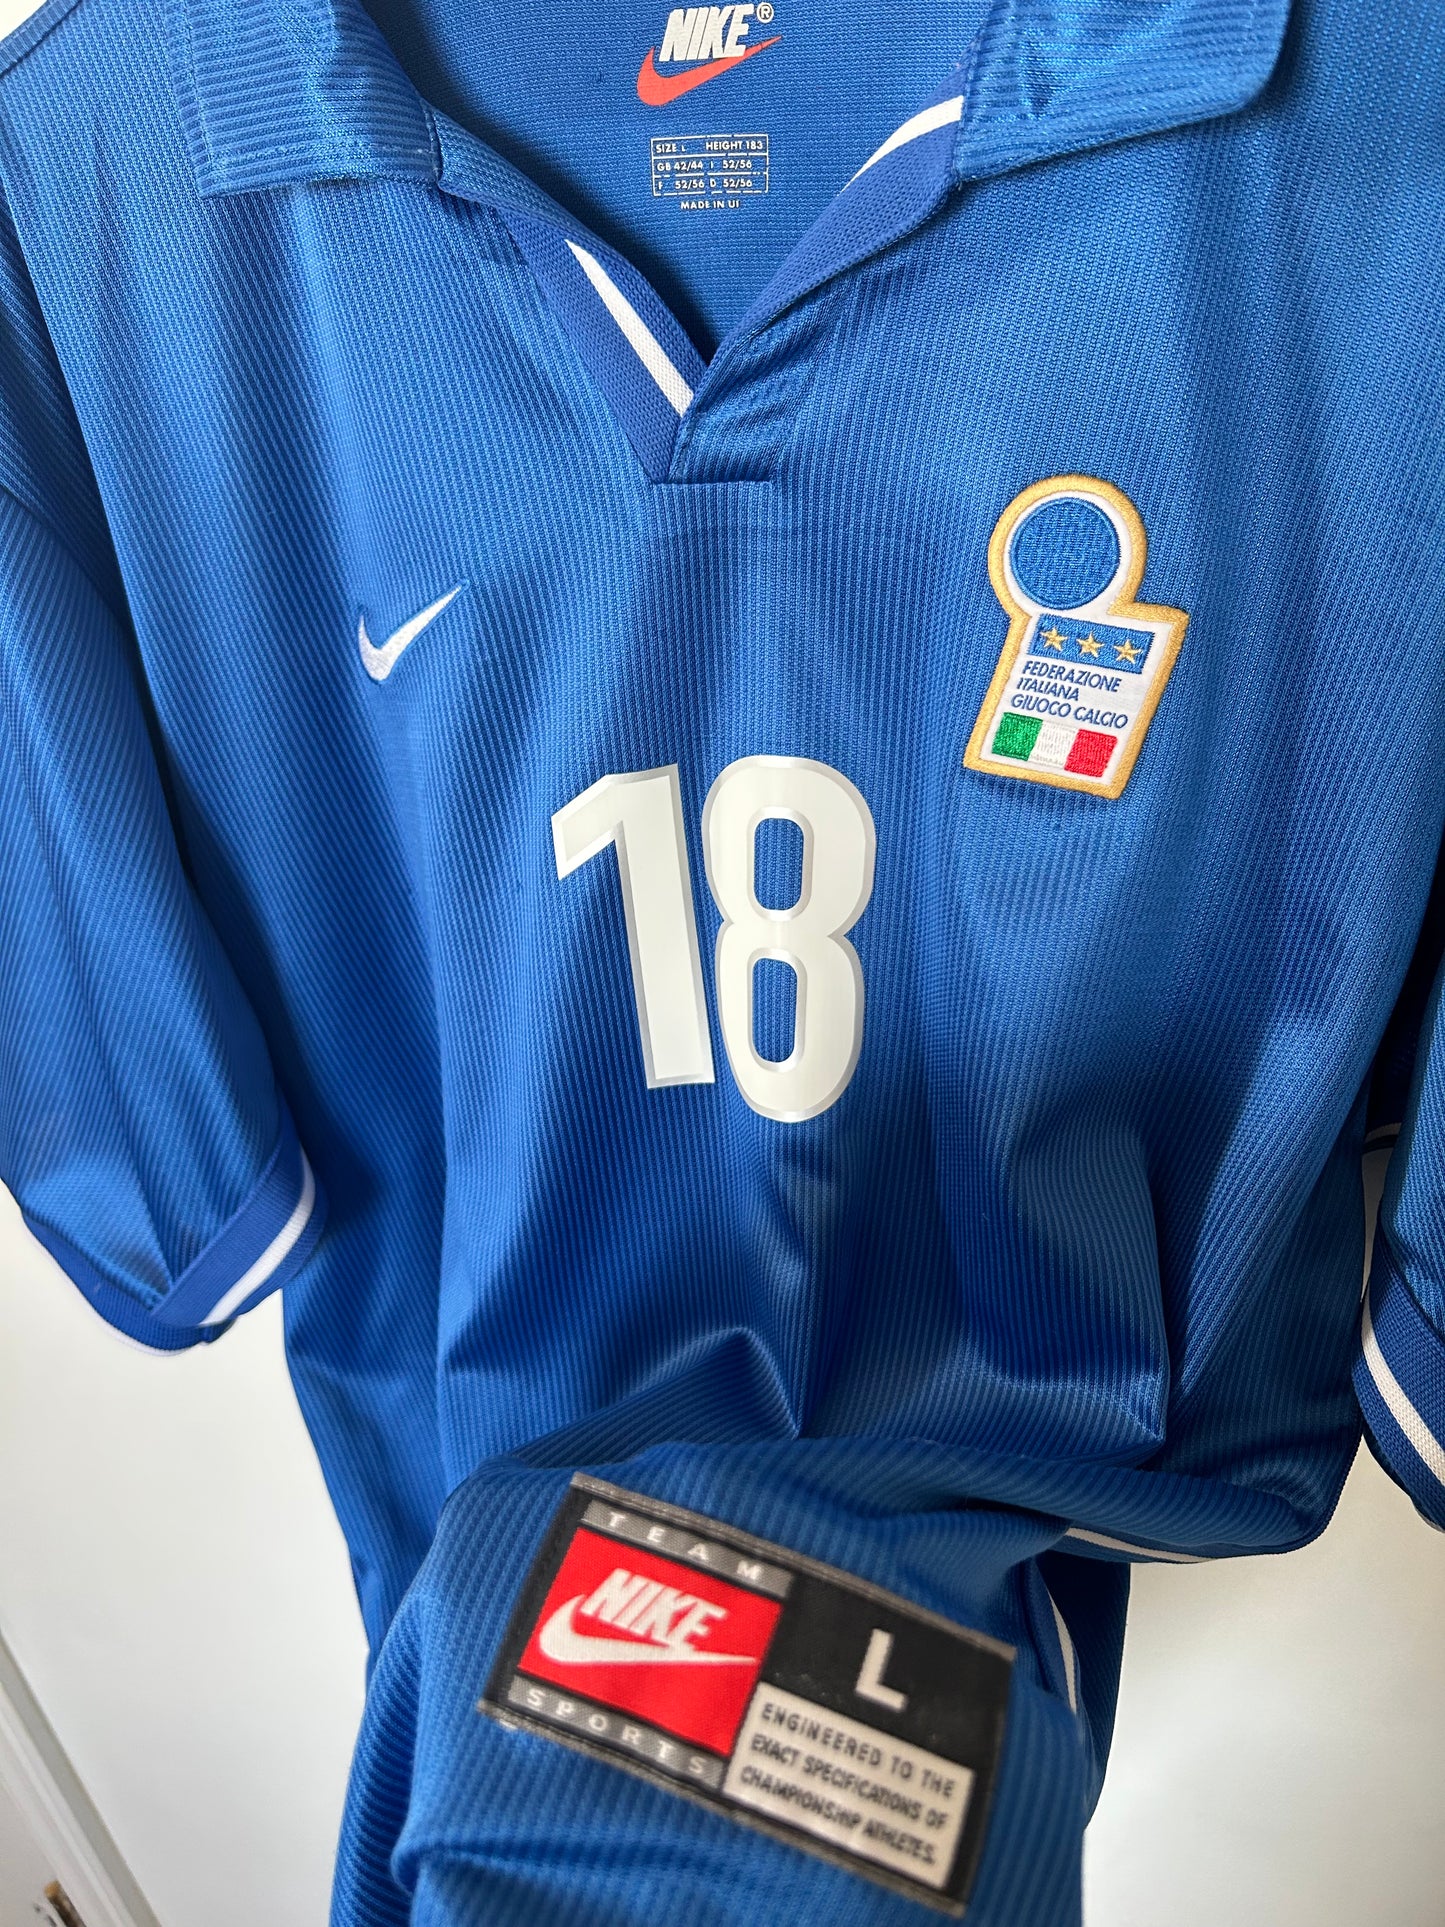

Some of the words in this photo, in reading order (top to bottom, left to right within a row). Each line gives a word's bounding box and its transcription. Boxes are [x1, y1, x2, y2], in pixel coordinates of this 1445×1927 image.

[656, 144, 677, 153] SIZE
[681, 144, 686, 152] L
[705, 141, 743, 150] HEIGHT
[746, 141, 763, 150] 183
[657, 163, 671, 171] GB
[674, 161, 704, 171] 42/44
[722, 160, 752, 169] 52/56
[675, 180, 705, 189] 52/56
[710, 179, 716, 188] D
[723, 179, 753, 188] 52/56
[681, 200, 710, 209] MADE
[713, 200, 725, 209] IN
[1016, 677, 1080, 701] ITALIANA
[1022, 660, 1122, 692] FEDERAZIONE
[1010, 694, 1072, 718] GIUOCO
[1073, 706, 1128, 729] CALCIO
[551, 754, 877, 1123] 18
[609, 1513, 762, 1580] TEAM
[579, 1567, 728, 1652] NIKE
[855, 1628, 908, 1713] L
[526, 1687, 704, 1775] SPORTS
[760, 1703, 882, 1766] ENGINEERED
[890, 1756, 914, 1780] TO
[921, 1768, 956, 1798] THE
[739, 1765, 861, 1830] CHAMPIONSHIP
[751, 1733, 799, 1768] EXACT
[803, 1757, 923, 1820] SPECIFICATIONS
[925, 1807, 949, 1831] OF
